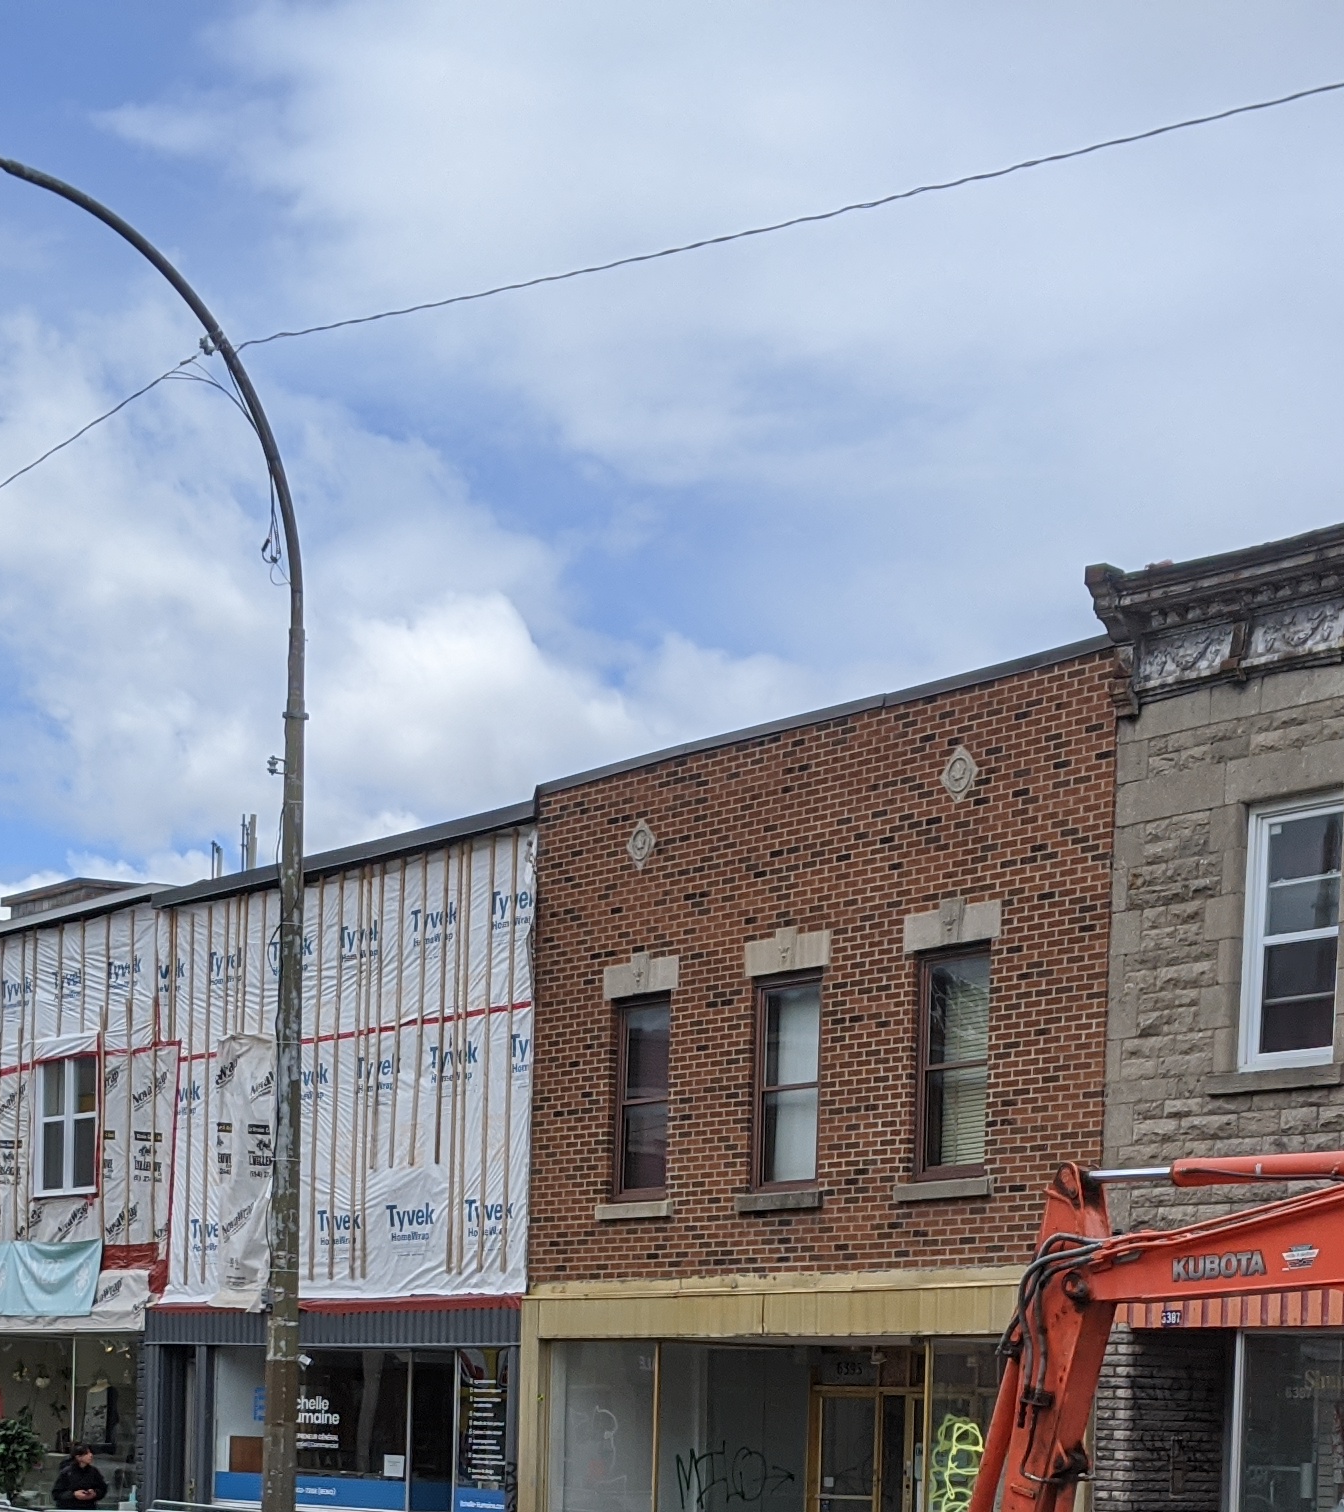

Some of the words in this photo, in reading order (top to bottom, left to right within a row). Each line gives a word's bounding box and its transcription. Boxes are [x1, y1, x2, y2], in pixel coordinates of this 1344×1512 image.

[386, 1203, 435, 1232] Tyvek
[391, 1231, 429, 1243] HomeWrap
[1172, 1250, 1267, 1281] KUBOTA
